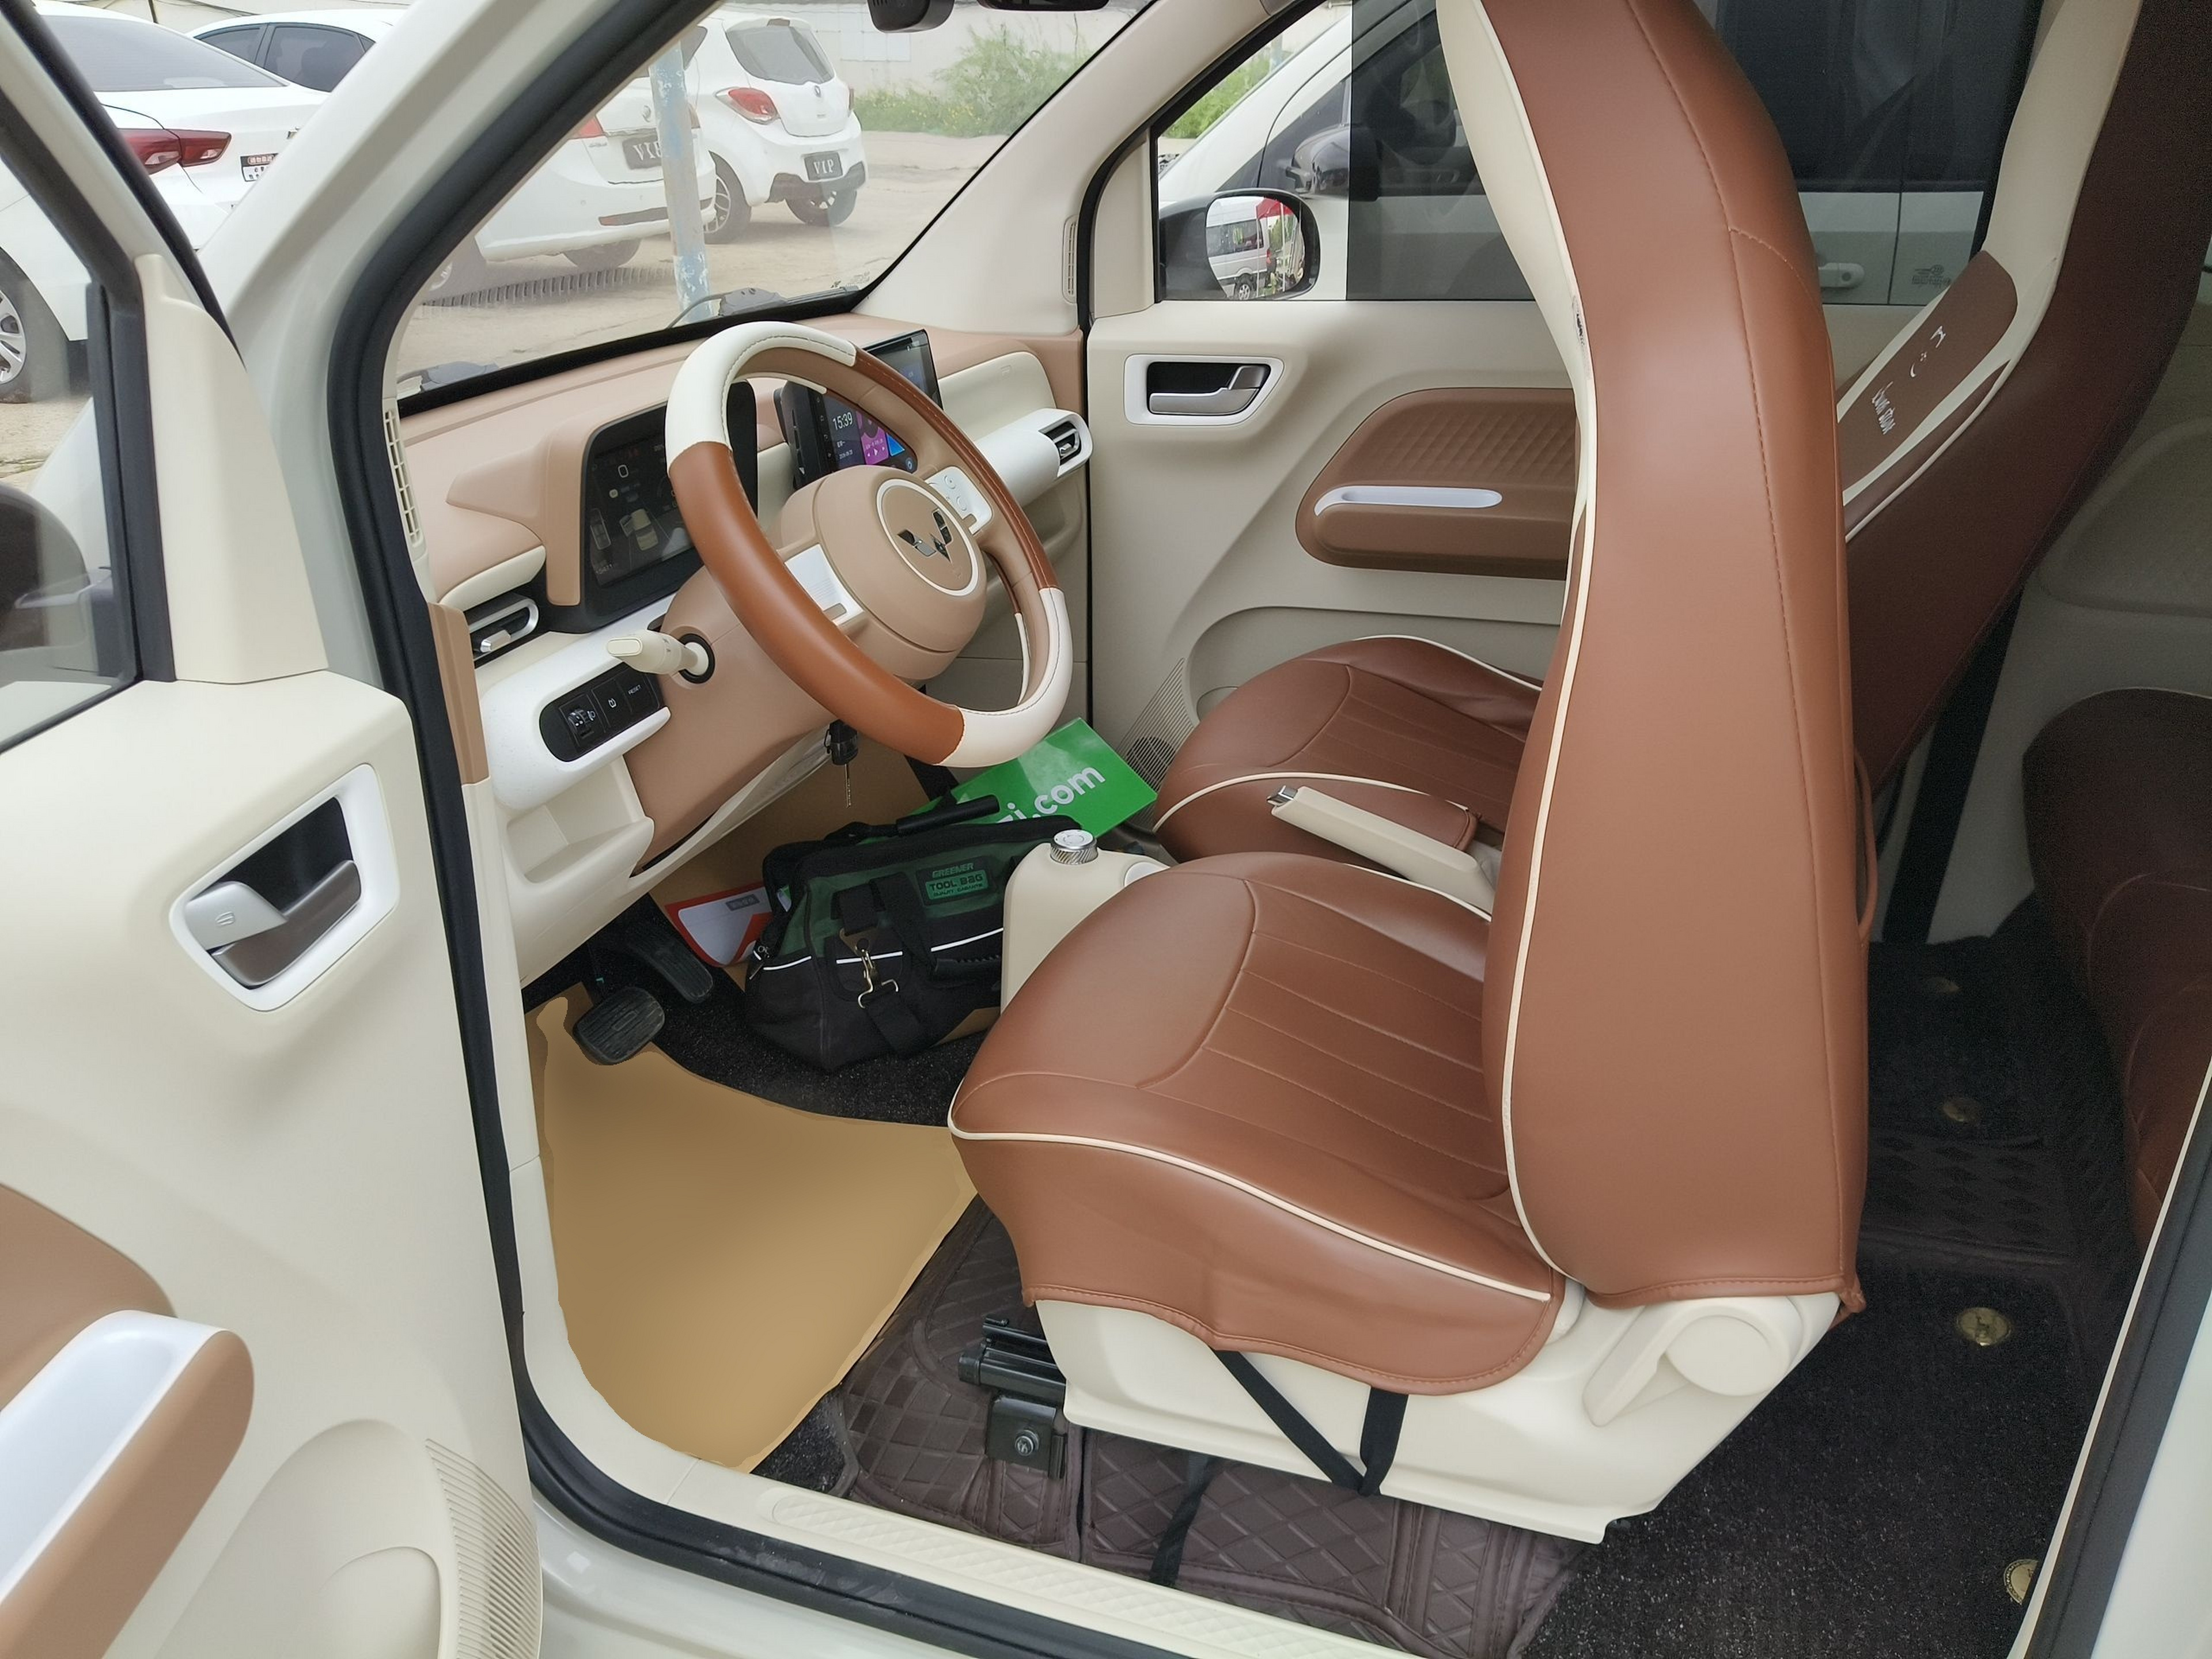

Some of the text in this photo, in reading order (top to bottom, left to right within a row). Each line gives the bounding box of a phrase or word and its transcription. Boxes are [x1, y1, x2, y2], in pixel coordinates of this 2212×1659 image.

[813, 158, 834, 175] VIP
[832, 411, 853, 431] 15:39
[929, 881, 957, 891] TOOL
